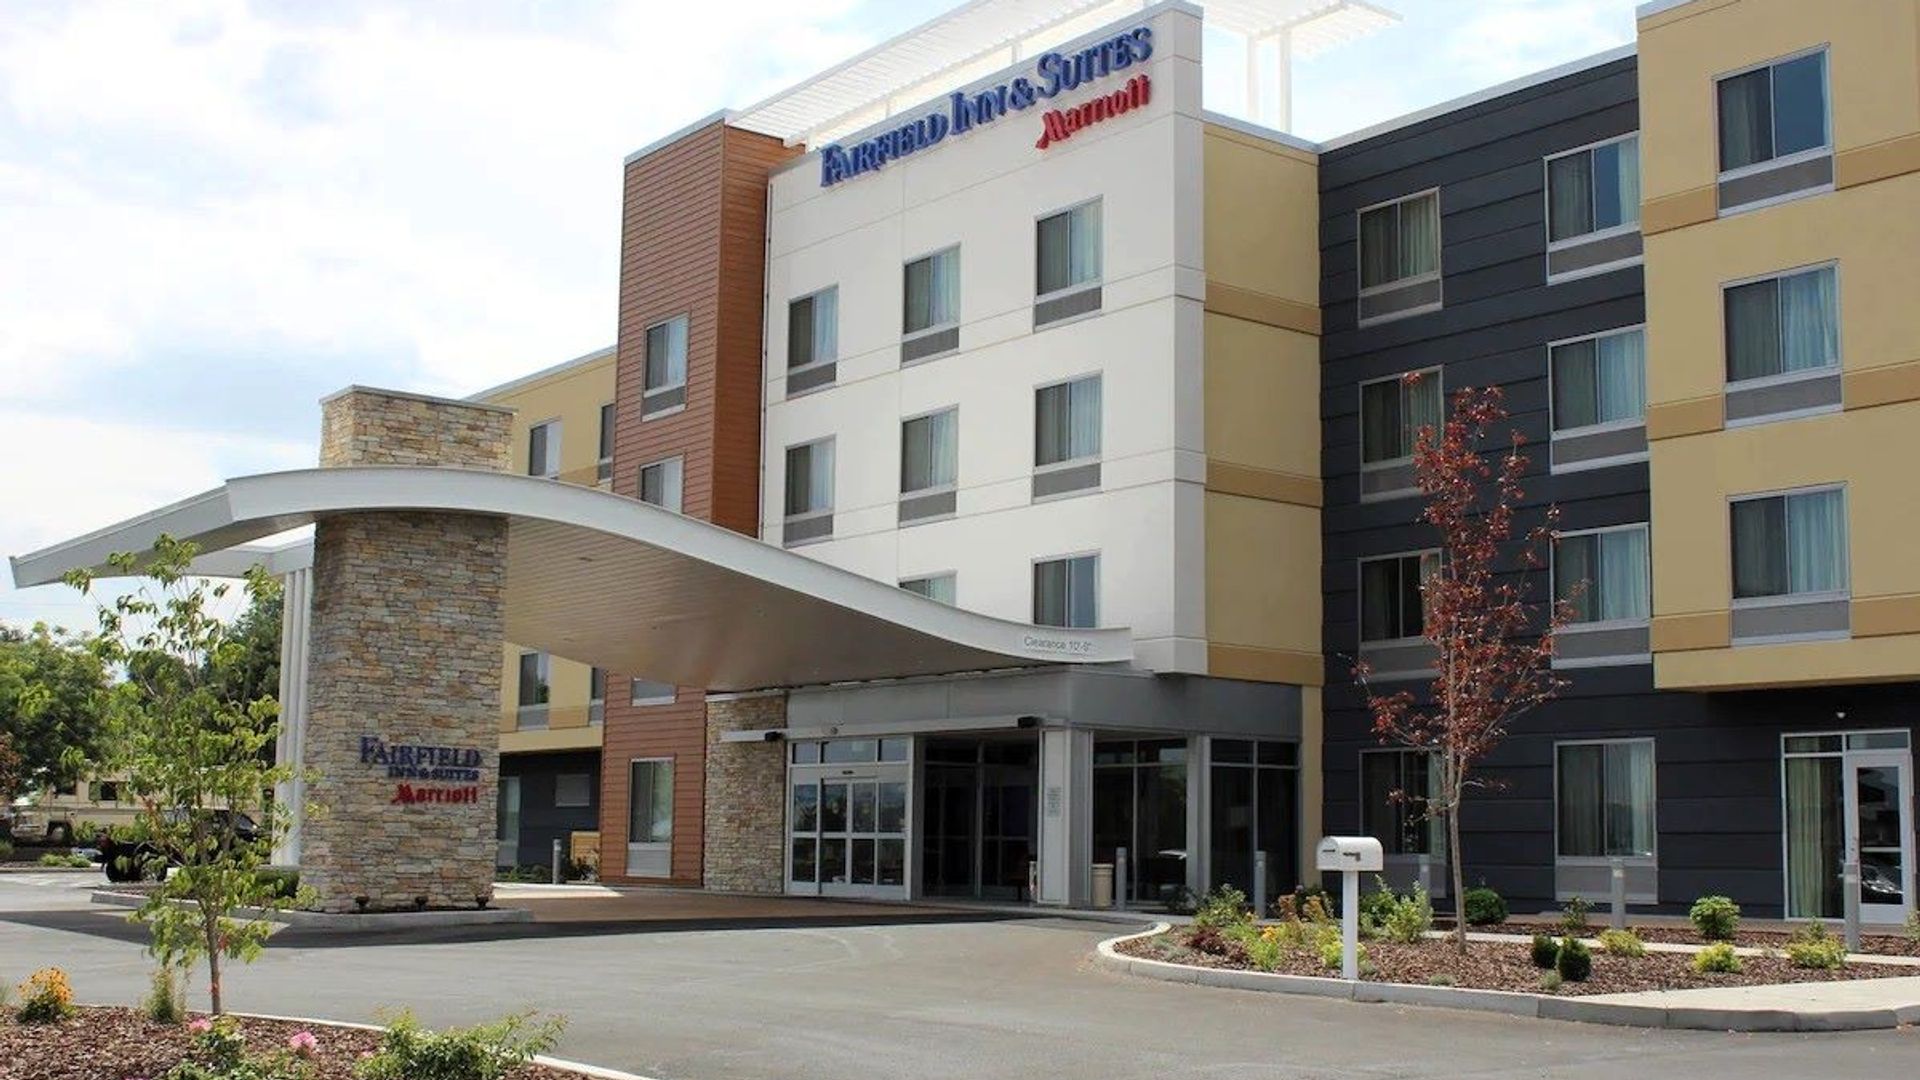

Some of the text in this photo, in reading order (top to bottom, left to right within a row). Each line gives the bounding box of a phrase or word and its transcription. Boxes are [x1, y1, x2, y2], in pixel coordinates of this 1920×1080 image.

[820, 27, 1153, 187] FAIRFIELD INN & SUITES
[1036, 74, 1151, 149] Marriott
[360, 735, 483, 768] FAIRFIELD
[388, 766, 418, 778] INN
[430, 768, 480, 781] SUITES
[391, 782, 478, 804] Marriott
